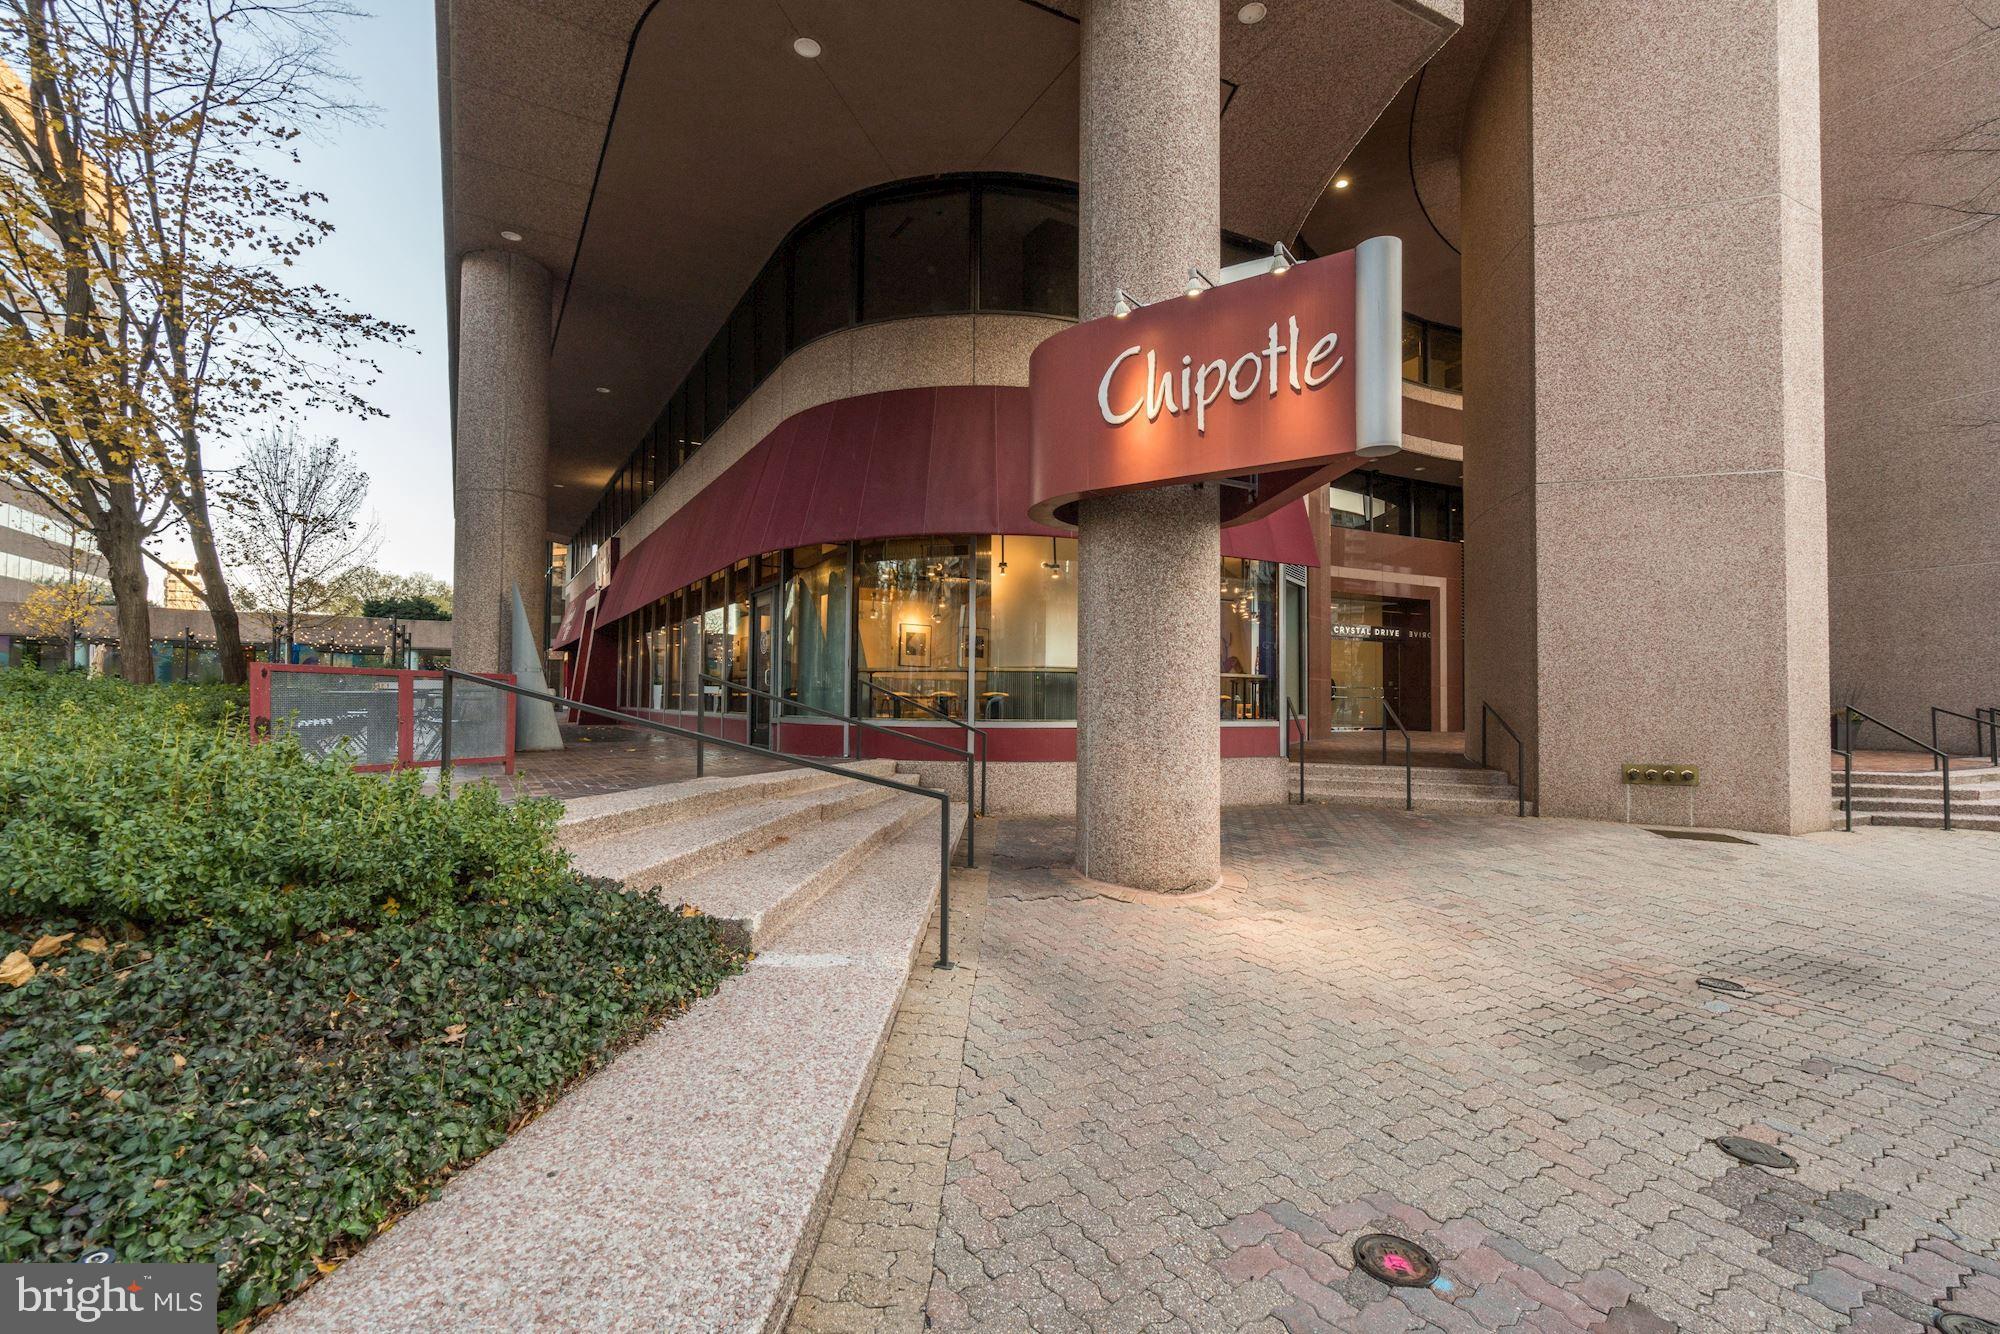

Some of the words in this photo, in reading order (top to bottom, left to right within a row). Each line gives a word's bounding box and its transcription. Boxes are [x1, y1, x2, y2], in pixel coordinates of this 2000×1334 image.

[1098, 315, 1344, 433] Chipotle
[1333, 625, 1371, 636] CRYSTAL
[1374, 629, 1400, 637] DRIVE
